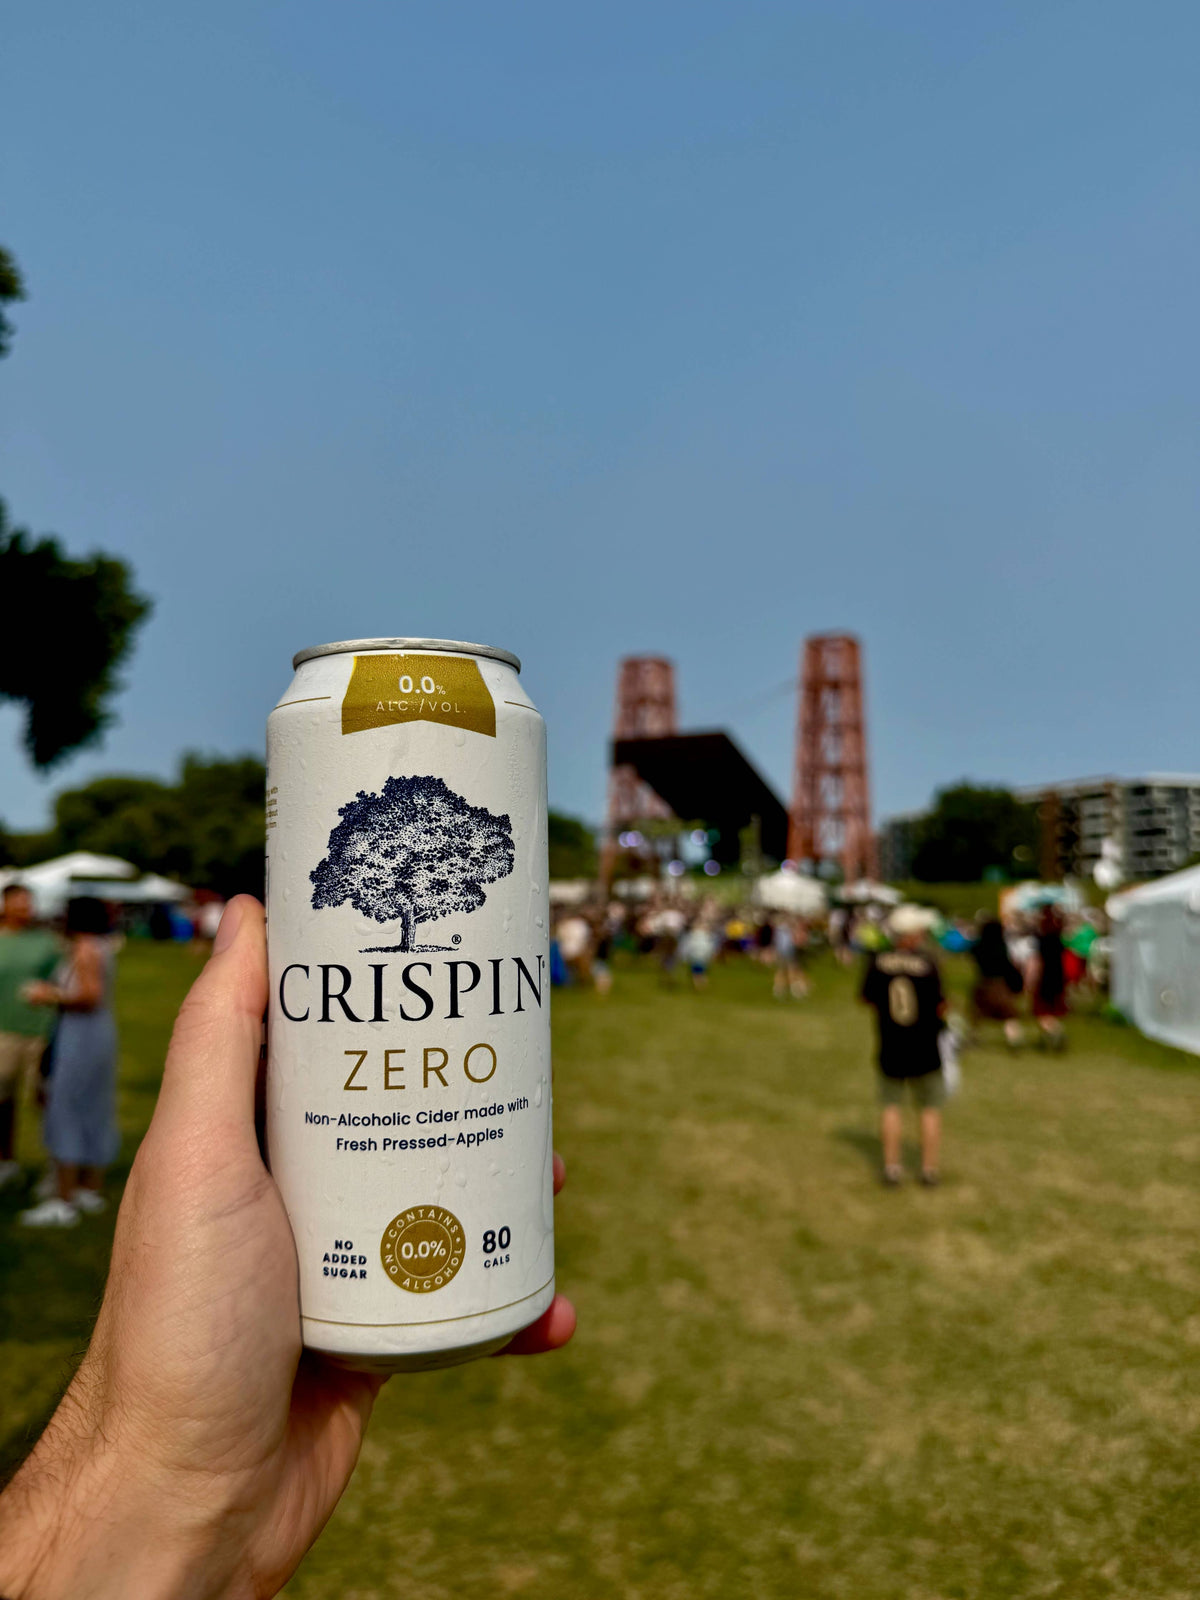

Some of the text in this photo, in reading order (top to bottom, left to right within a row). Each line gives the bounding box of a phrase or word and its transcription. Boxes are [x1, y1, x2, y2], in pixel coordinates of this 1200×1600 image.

[399, 675, 446, 695] 0.0%
[279, 955, 544, 1023] CRISPIN
[343, 1043, 498, 1091] ZERO
[305, 1097, 529, 1127] Non-Alcoholic Cider made with
[336, 1127, 504, 1151] Fresh Pressed-Apples
[388, 1209, 458, 1238] CONTAINS
[334, 1240, 353, 1250] NO
[401, 1240, 446, 1259] 0.0%
[482, 1225, 511, 1254] 80
[322, 1253, 367, 1265] ADDED
[385, 1248, 462, 1289] NO ALCOHOL
[483, 1254, 510, 1269] CALS
[323, 1266, 367, 1280] SUGAR
